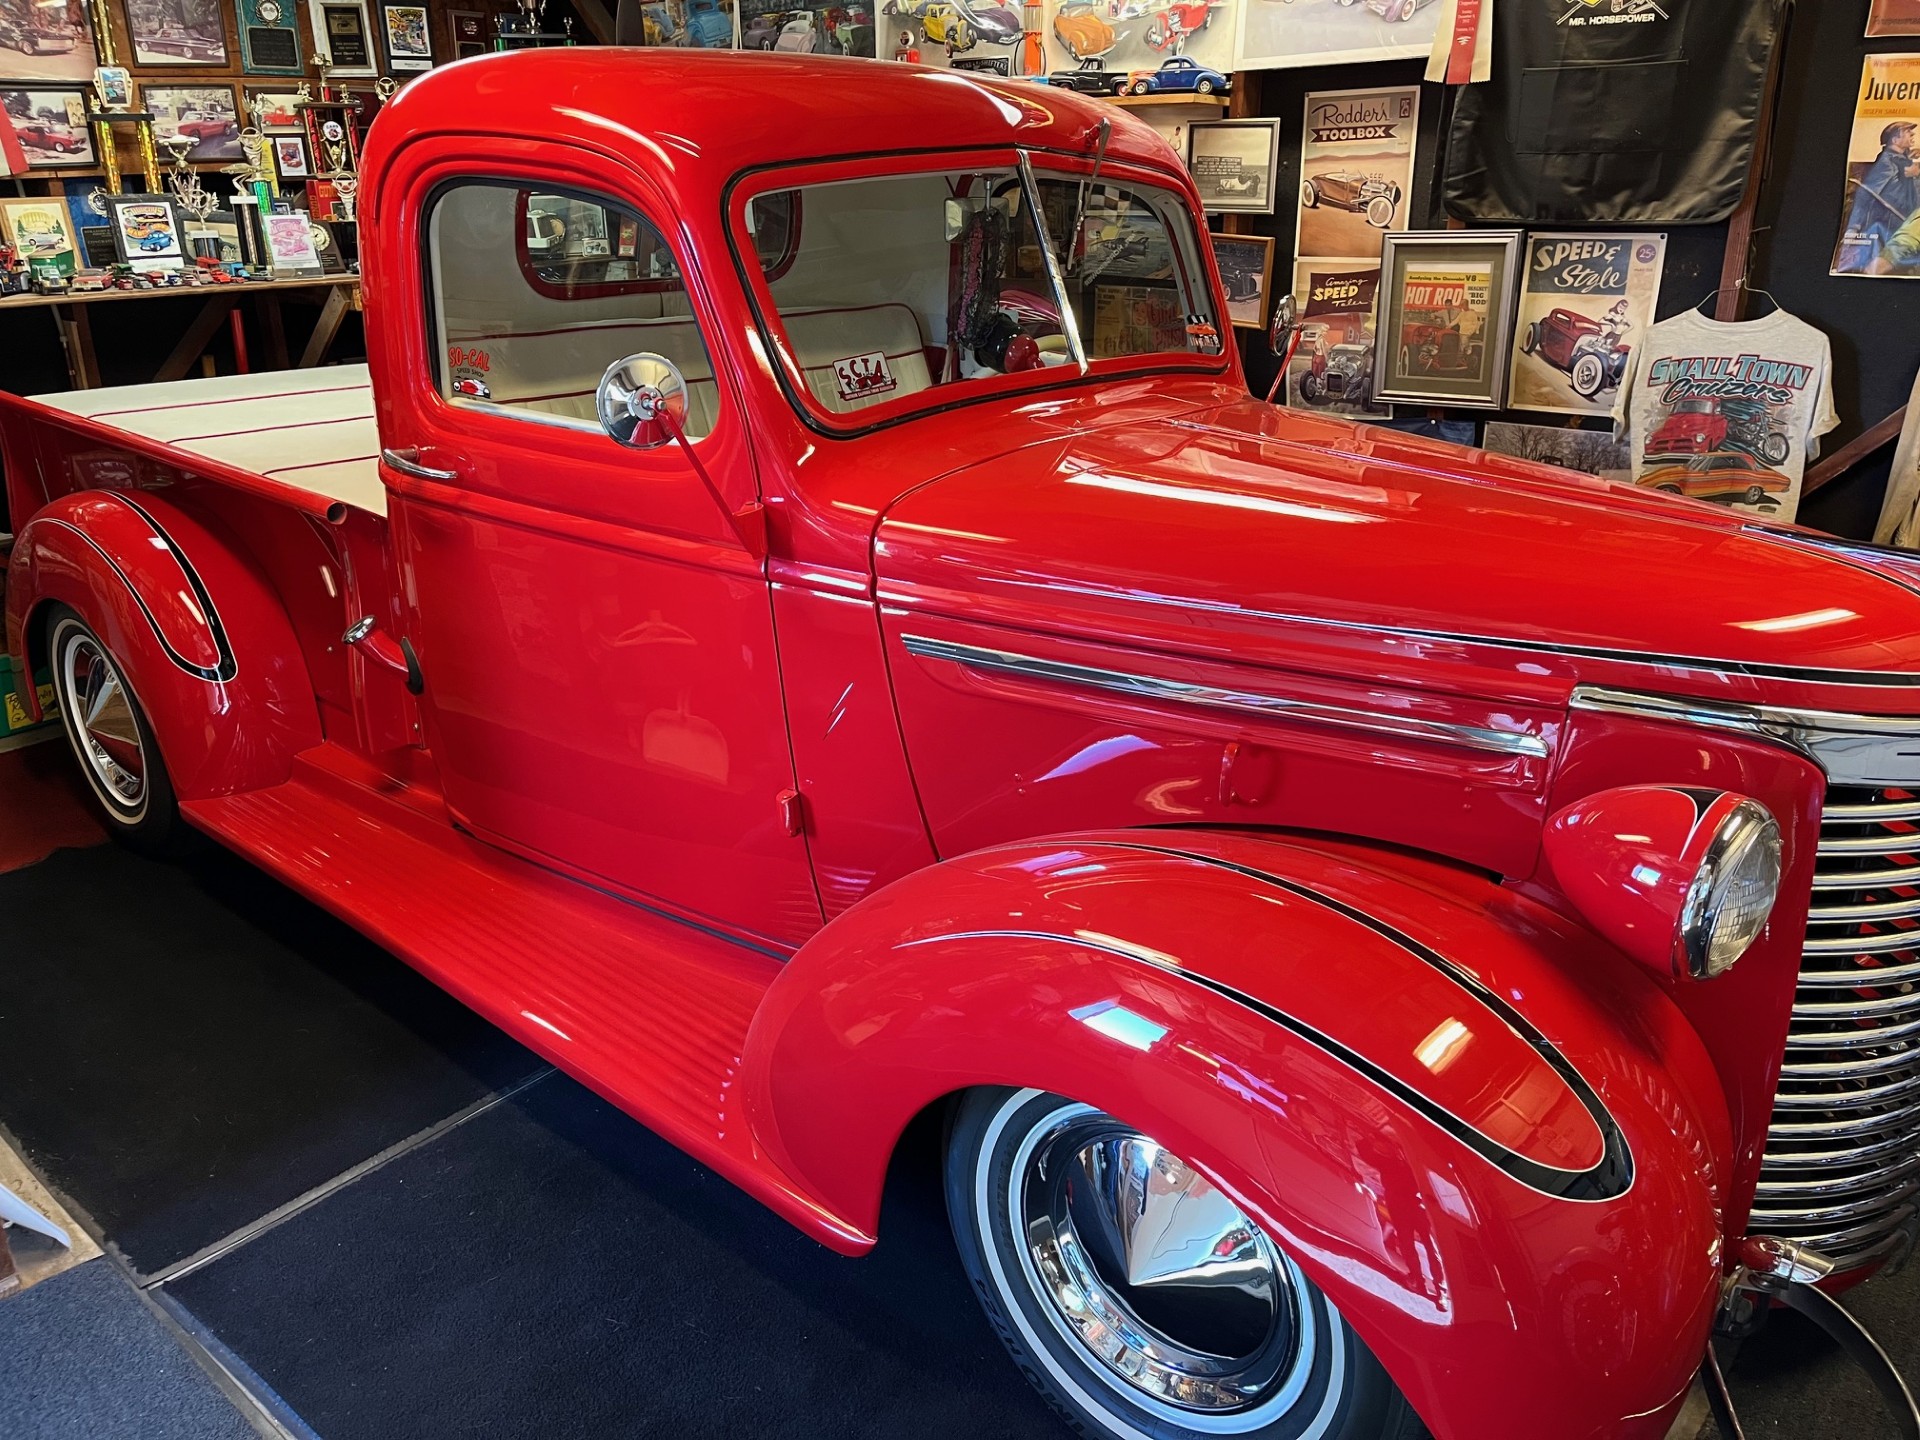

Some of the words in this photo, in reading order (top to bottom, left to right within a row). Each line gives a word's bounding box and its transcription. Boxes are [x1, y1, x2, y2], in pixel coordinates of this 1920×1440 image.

[1569, 17, 1587, 26] MR.
[1589, 13, 1655, 26] HORSEPOWER
[1865, 77, 1920, 100] Juven
[1311, 102, 1391, 127] Rodder's
[1319, 127, 1386, 141] TOOLBOX
[1533, 241, 1607, 272] SPEED
[1604, 244, 1621, 264] &
[1325, 277, 1369, 287] Amazing
[1554, 264, 1628, 293] Style
[1312, 285, 1359, 301] SPEED
[1404, 286, 1433, 305] HOT
[1433, 287, 1464, 306] ROD
[448, 346, 490, 372] SO-CAL
[838, 358, 884, 387] SCTA
[1648, 356, 1732, 387] SMALL
[1731, 354, 1814, 391] TOWN
[1660, 376, 1794, 406] Cruizers
